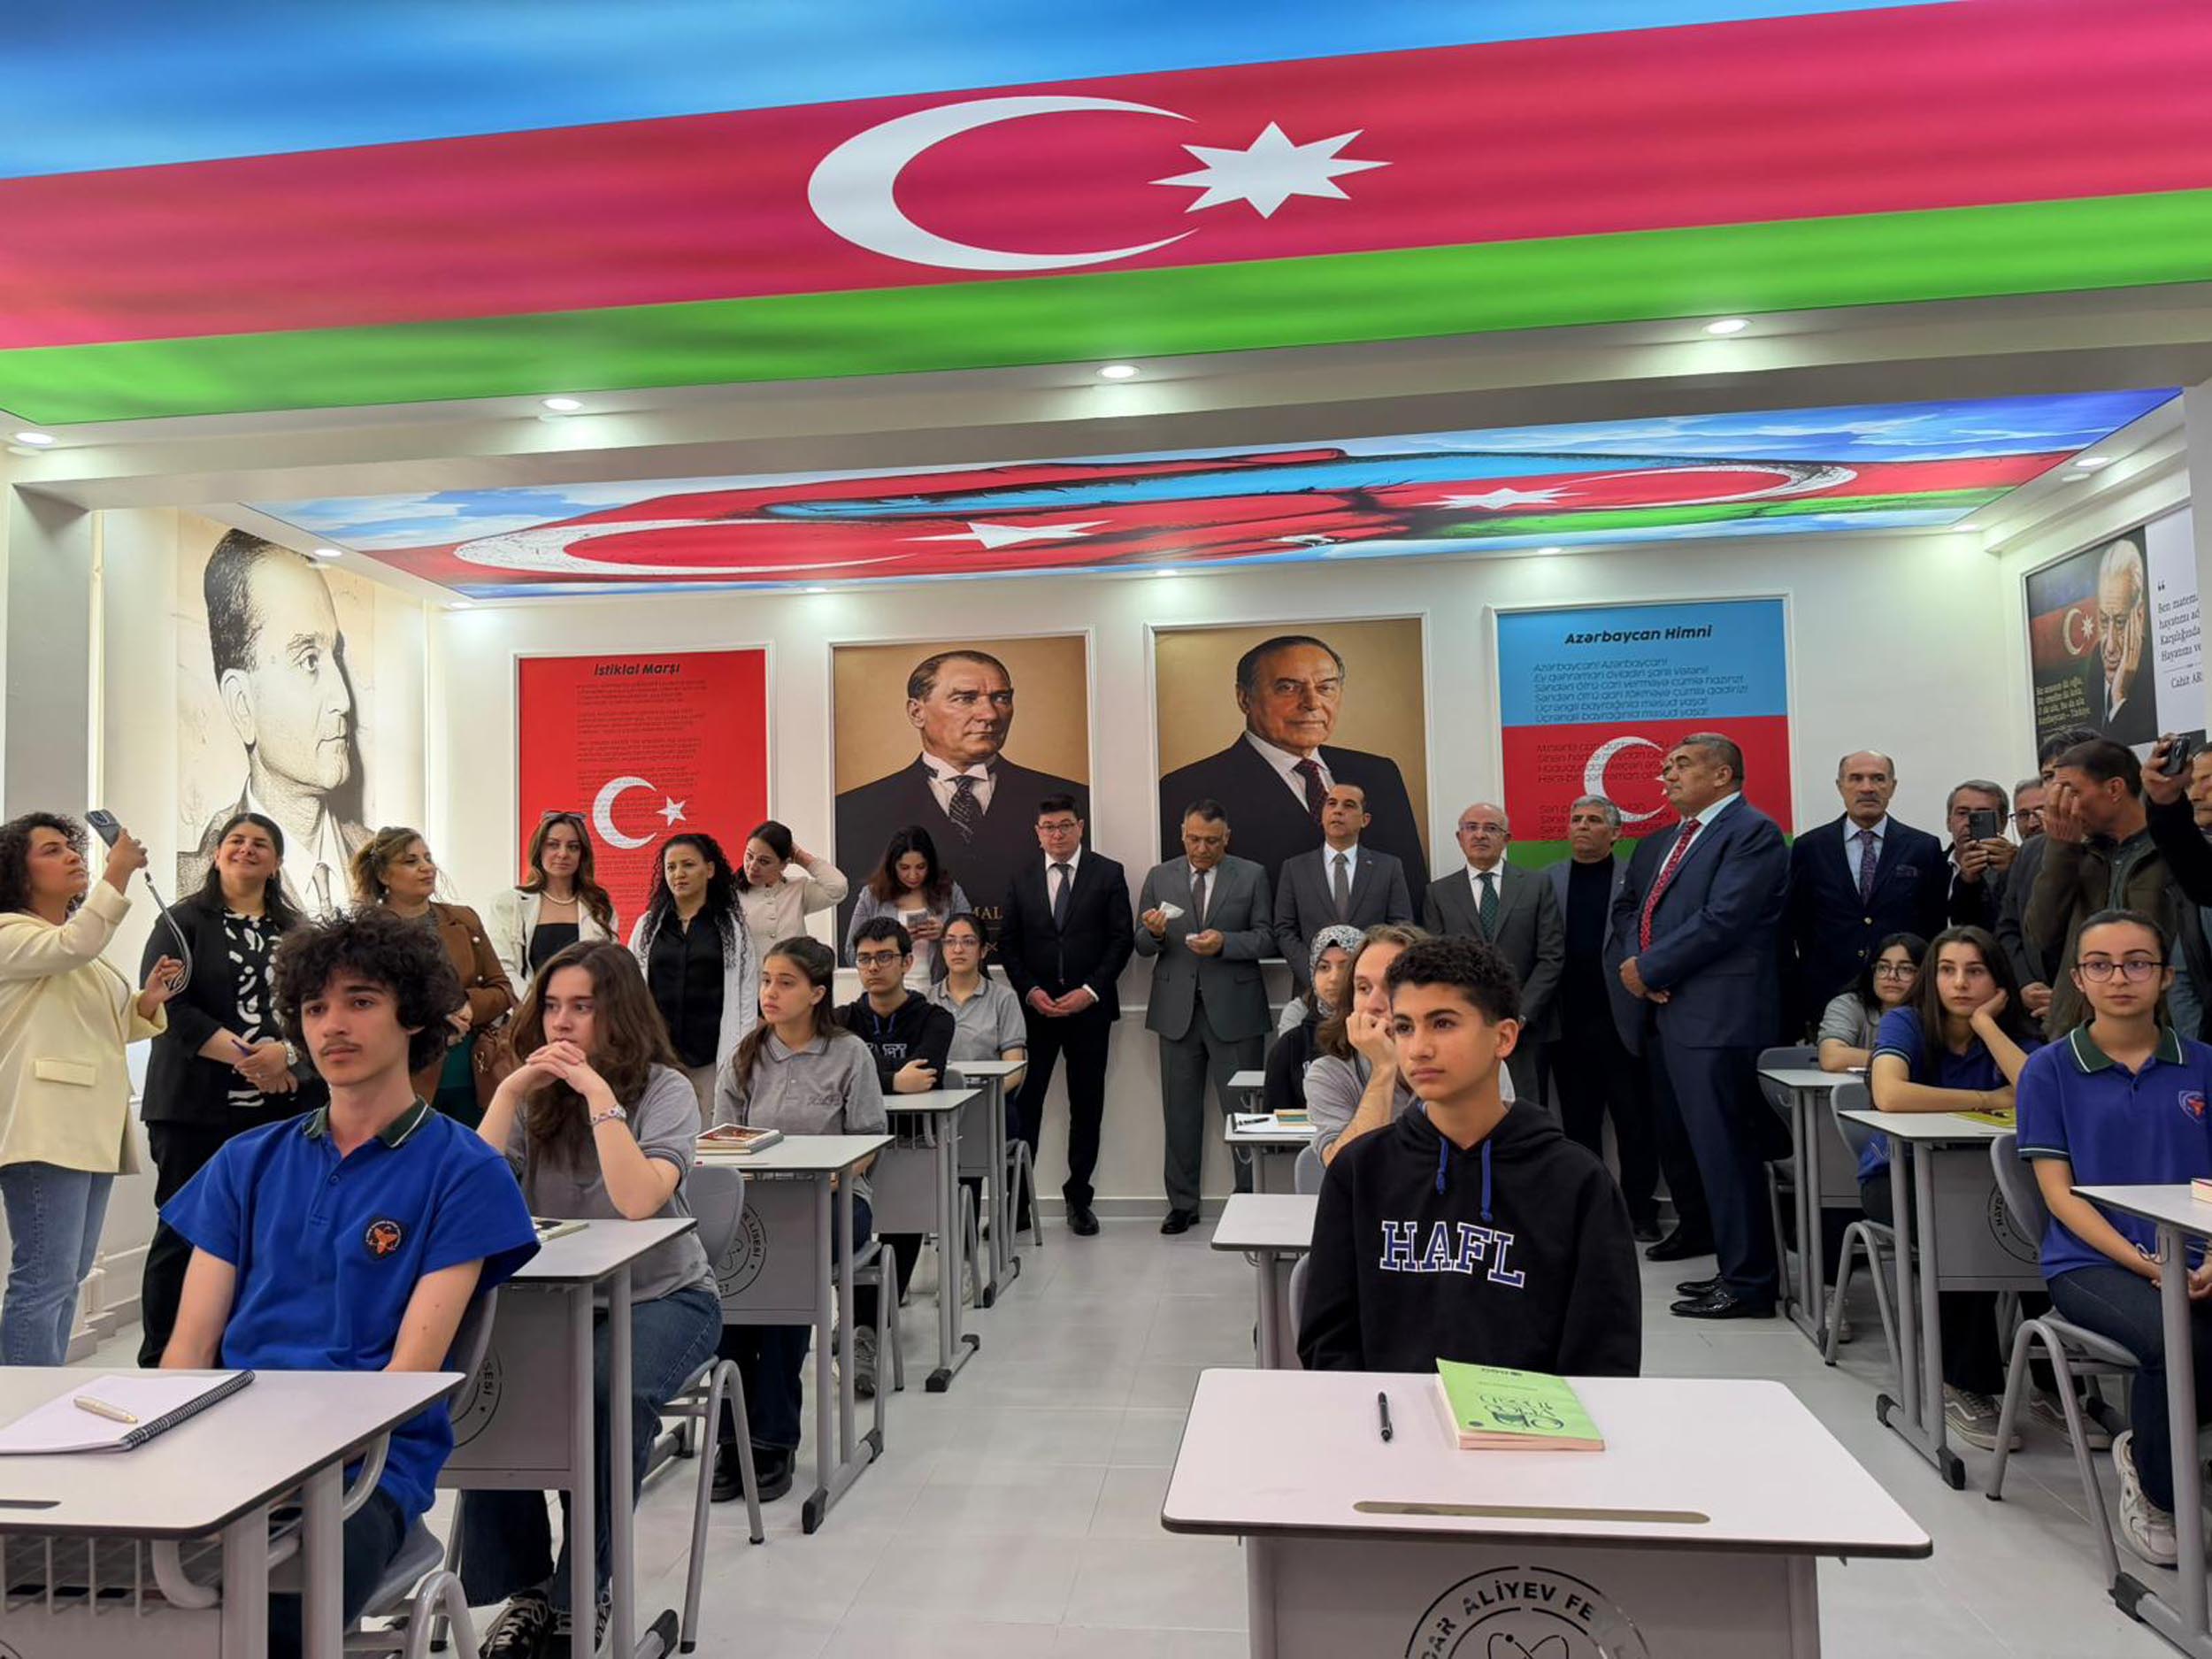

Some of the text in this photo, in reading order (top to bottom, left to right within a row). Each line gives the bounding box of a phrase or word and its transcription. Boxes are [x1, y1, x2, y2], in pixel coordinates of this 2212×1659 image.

[1563, 625, 1713, 644] Azərbaycan Himni
[1379, 1220, 1525, 1288] HAFL
[1463, 1580, 1557, 1616] ALİYEV
[1565, 1594, 1596, 1622] FE
